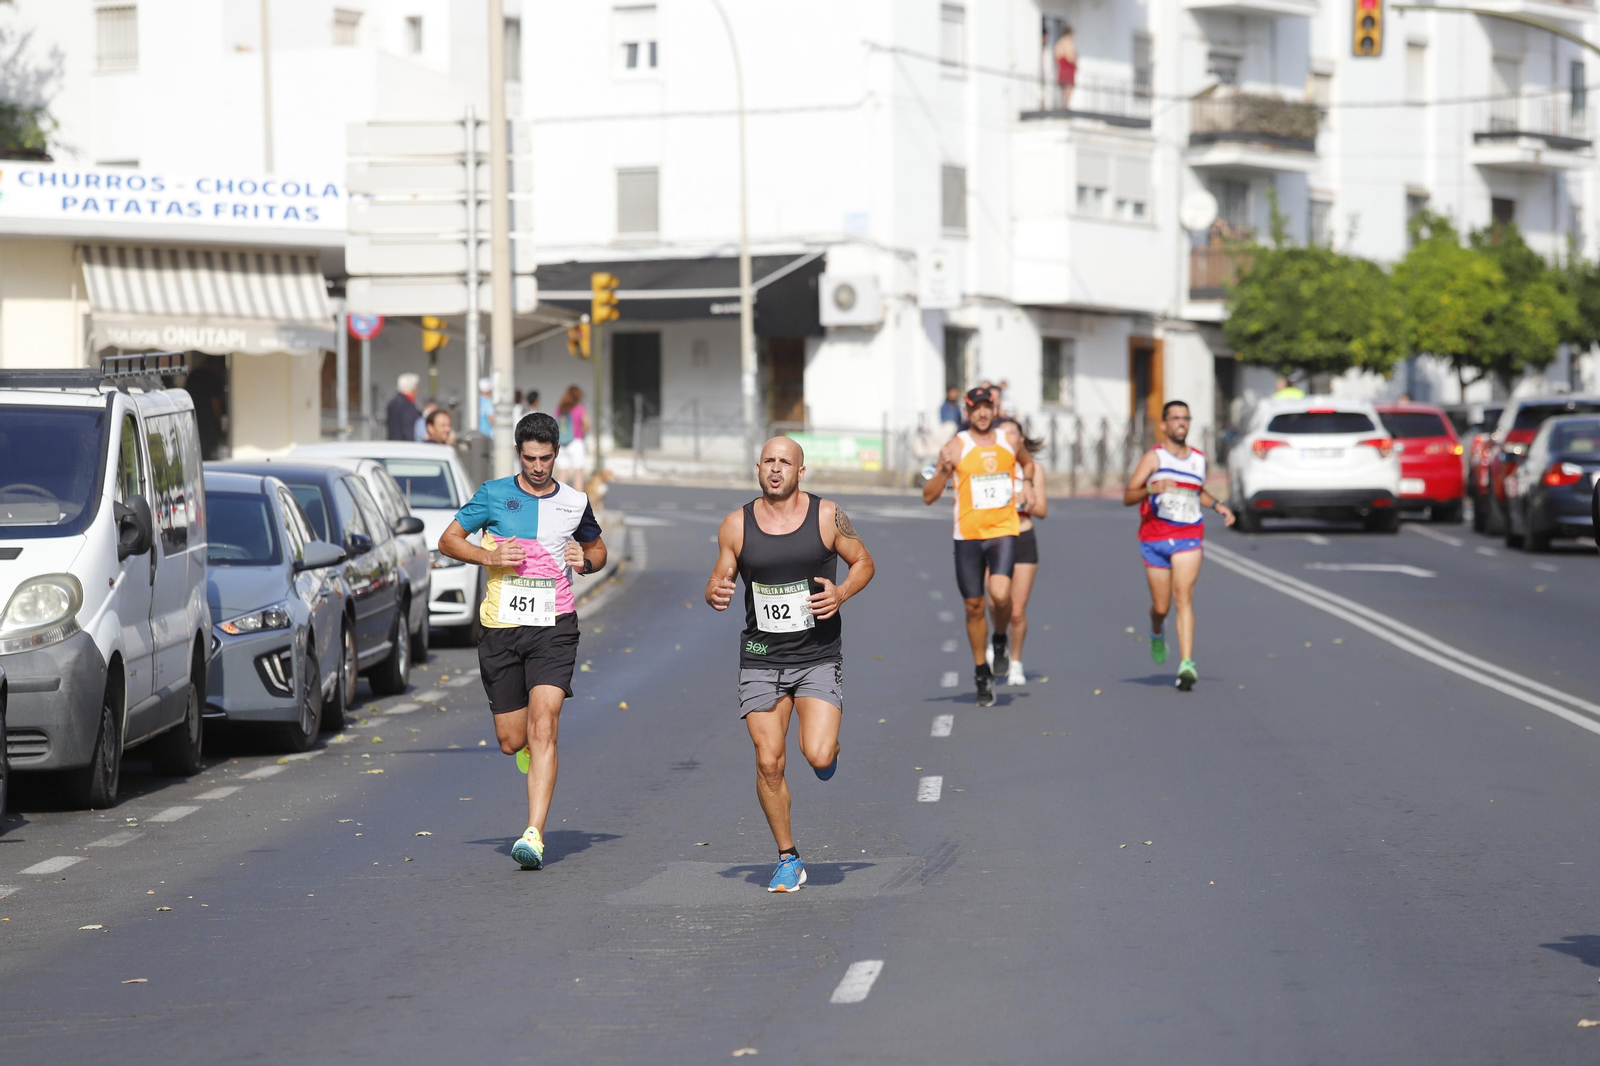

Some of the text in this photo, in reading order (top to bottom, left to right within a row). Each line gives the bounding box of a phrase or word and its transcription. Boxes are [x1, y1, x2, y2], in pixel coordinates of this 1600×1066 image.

[18, 169, 166, 191] CHURROS
[195, 177, 372, 199] CHOCOLA
[61, 194, 321, 222] PATATAS FRITAS
[162, 325, 247, 348] ONUTAPI
[984, 487, 996, 498] 12
[513, 578, 530, 588] VUELTA
[535, 580, 553, 588] HUELVA
[761, 587, 779, 595] VUELTA
[785, 584, 805, 594] HUELVA
[509, 595, 535, 613] 451
[763, 603, 792, 620] 182
